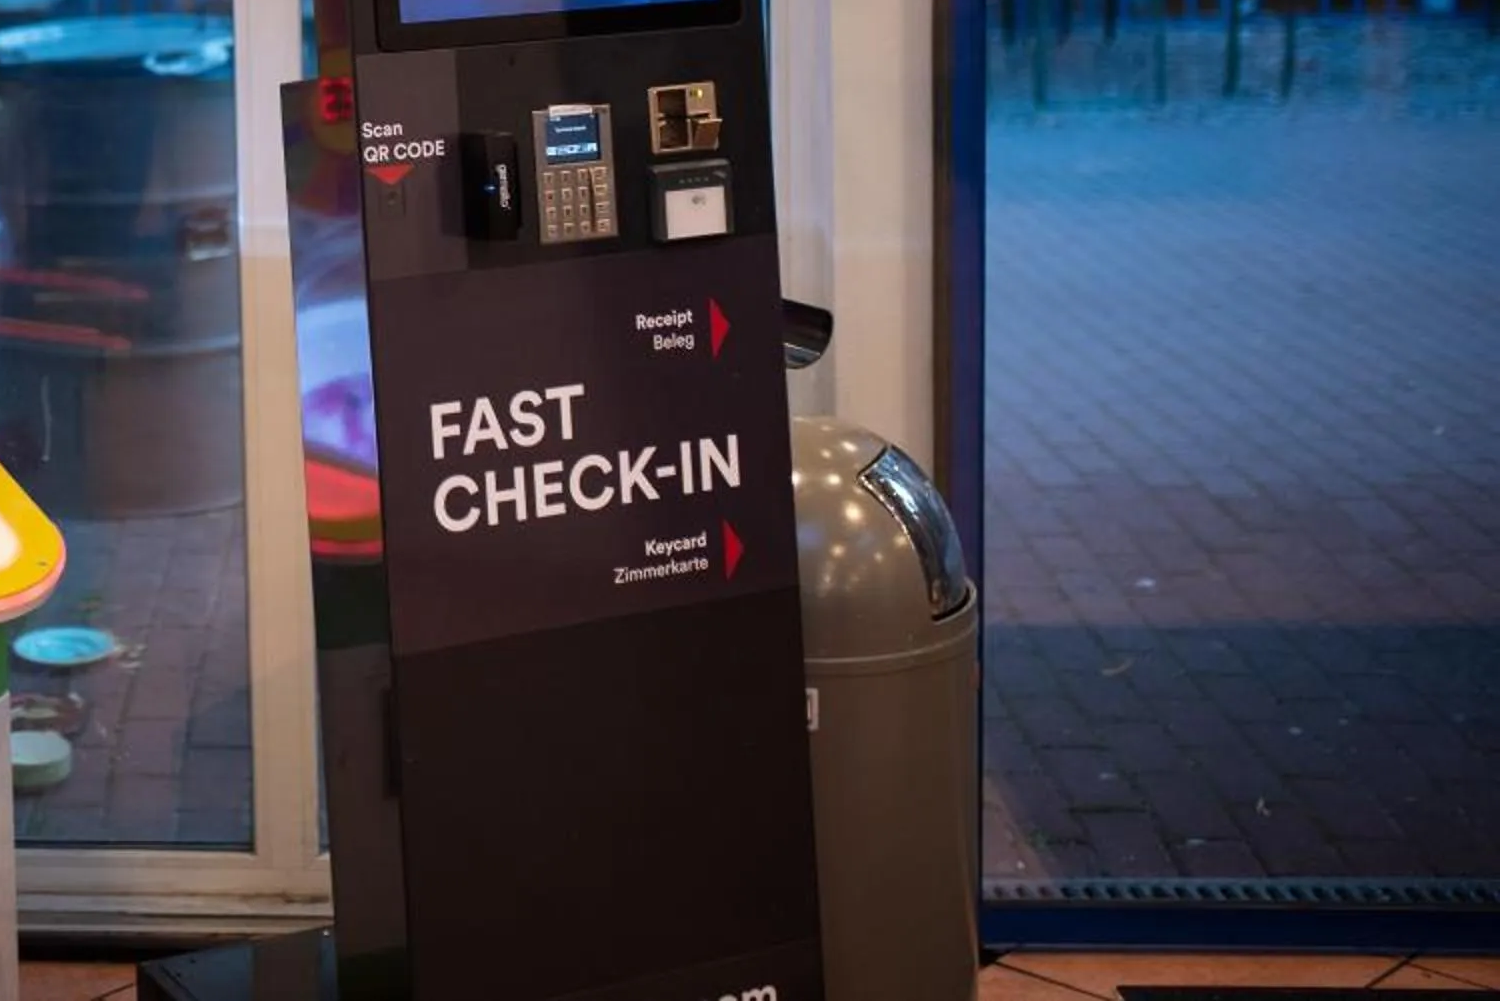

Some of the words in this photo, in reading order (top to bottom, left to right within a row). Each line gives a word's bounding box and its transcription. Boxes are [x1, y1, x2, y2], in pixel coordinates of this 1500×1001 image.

[362, 121, 404, 138] Scan
[363, 144, 390, 163] QR
[392, 139, 446, 160] CODE
[635, 309, 694, 330] Receipt
[652, 332, 696, 351] Beleg
[429, 383, 585, 460] FAST
[432, 433, 742, 533] CHECK-IN
[644, 530, 708, 556] Keycard
[612, 557, 709, 585] Zimmerkarte
